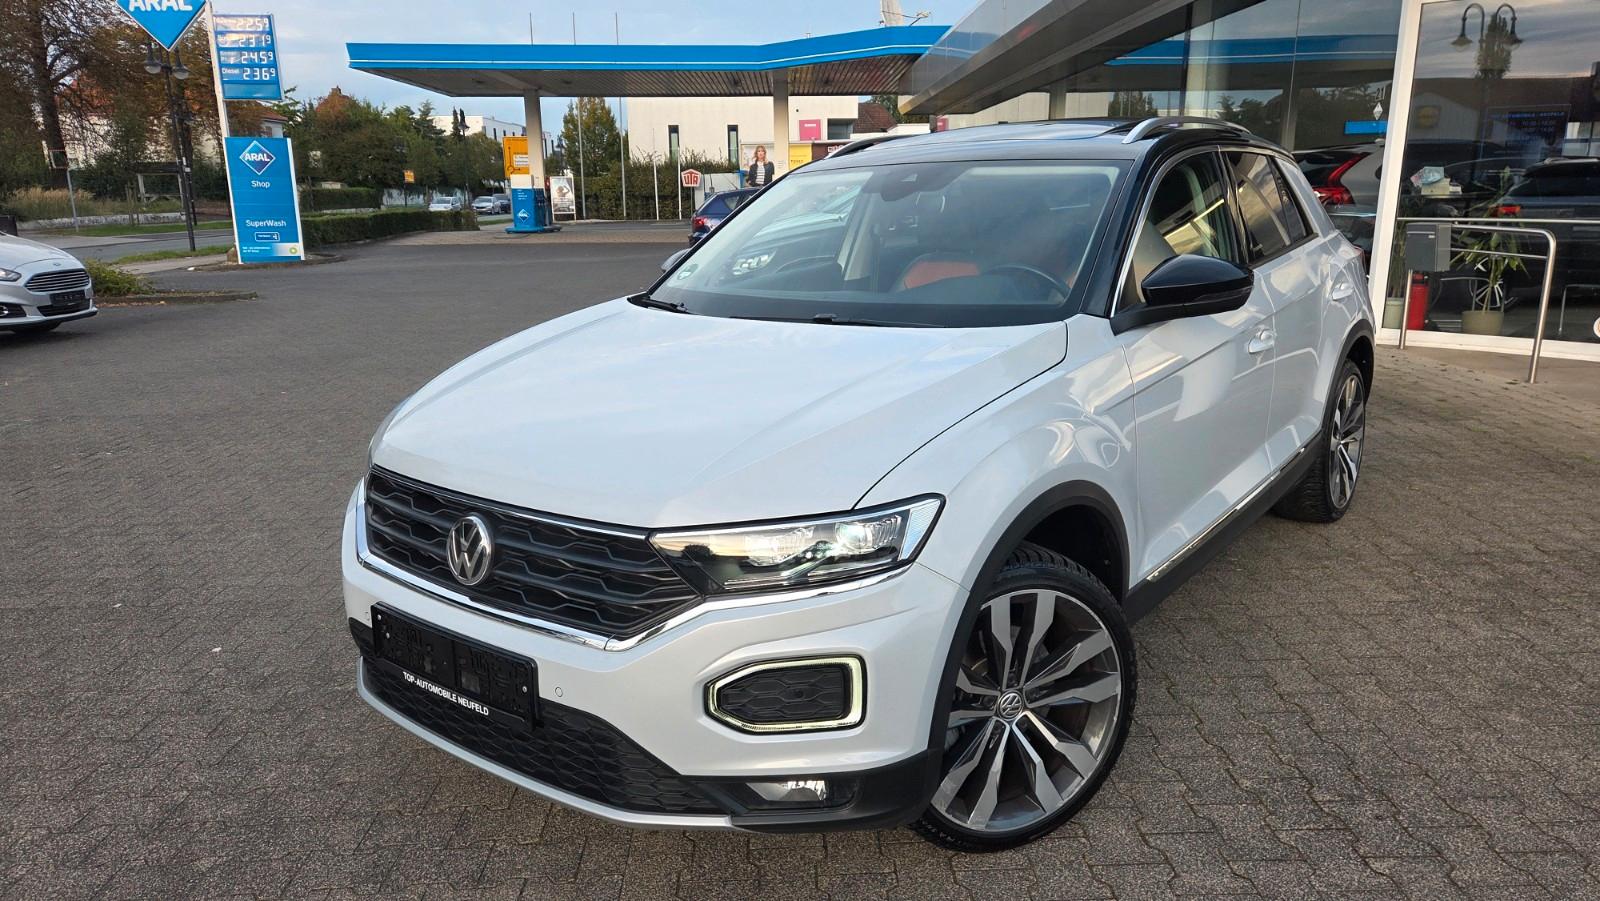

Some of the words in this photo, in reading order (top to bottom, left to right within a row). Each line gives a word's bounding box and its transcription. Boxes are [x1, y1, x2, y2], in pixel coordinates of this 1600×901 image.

[129, 0, 193, 11] ARAL
[241, 51, 273, 64] 2459
[243, 67, 276, 80] 2369
[244, 152, 270, 161] ARAL
[251, 180, 270, 188] Shop
[246, 219, 287, 227] SuperWash
[402, 671, 457, 703] TOP-AUTOMOBILE
[457, 697, 489, 716] NEUFELD
